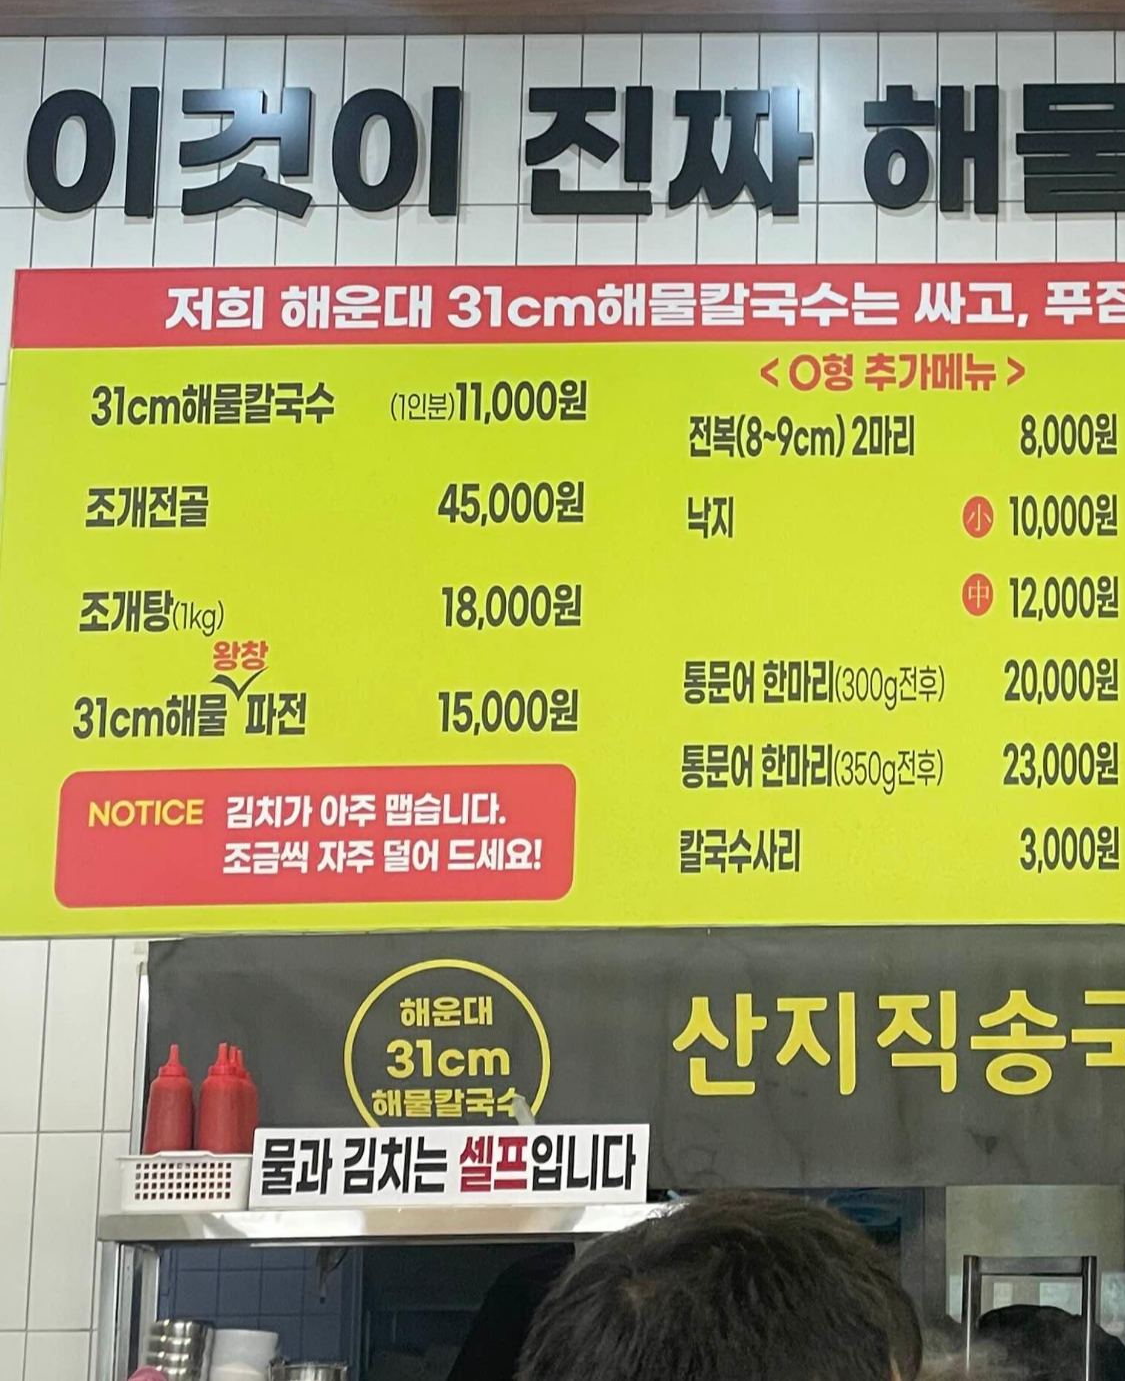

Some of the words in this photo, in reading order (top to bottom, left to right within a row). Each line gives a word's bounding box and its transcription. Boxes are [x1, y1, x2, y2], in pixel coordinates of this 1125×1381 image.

[26, 86, 462, 219] 이것이
[525, 83, 813, 217] 진짜
[166, 286, 264, 330] 저희
[281, 285, 432, 329] 해운대
[448, 282, 899, 328] 31cm해물칼국수는
[915, 282, 1028, 327] 싸고,
[865, 353, 996, 391] 추가메뉴
[92, 382, 334, 426] 31cm해물칼국수
[690, 414, 845, 458] 전복(8~9cm)
[852, 415, 914, 456] 2마리
[1021, 414, 1117, 458] 8,000원
[86, 486, 208, 527] 조개전골
[438, 481, 584, 526] 45,000원
[688, 497, 733, 538] 낙지
[1010, 494, 1117, 539] 10,000원
[80, 590, 223, 637] 조개탕(1kg)
[442, 585, 581, 630] 18,000원
[1010, 576, 1118, 621] 12,000원
[213, 641, 268, 671] 왕창
[684, 661, 754, 704] 통문어
[763, 660, 944, 711] 한마리(300g전후)
[1005, 658, 1118, 704] 20,000원
[73, 694, 227, 739] 31cm해물
[244, 692, 307, 736] 파전
[439, 689, 578, 735] 15,000원
[682, 745, 753, 788] 통문어
[762, 744, 943, 795] 한마리(350g전후)
[1003, 742, 1118, 788] 23,000원
[89, 799, 204, 827] NOTICE
[227, 796, 312, 828] 김치가
[321, 795, 376, 827] 아주
[386, 793, 506, 826] 맵습니다.
[223, 841, 308, 874] 조금씩
[318, 841, 374, 873] 자주
[384, 839, 438, 872] 덜어
[448, 838, 542, 870] 드세요!
[681, 829, 800, 873] 칼국수사리
[1020, 826, 1119, 873] 3,000원
[400, 996, 492, 1026] 해운대
[387, 1039, 509, 1078] 31cm
[262, 1138, 332, 1195] 물과
[344, 1137, 447, 1194] 김치는
[460, 1134, 636, 1192] 셀프입니다
